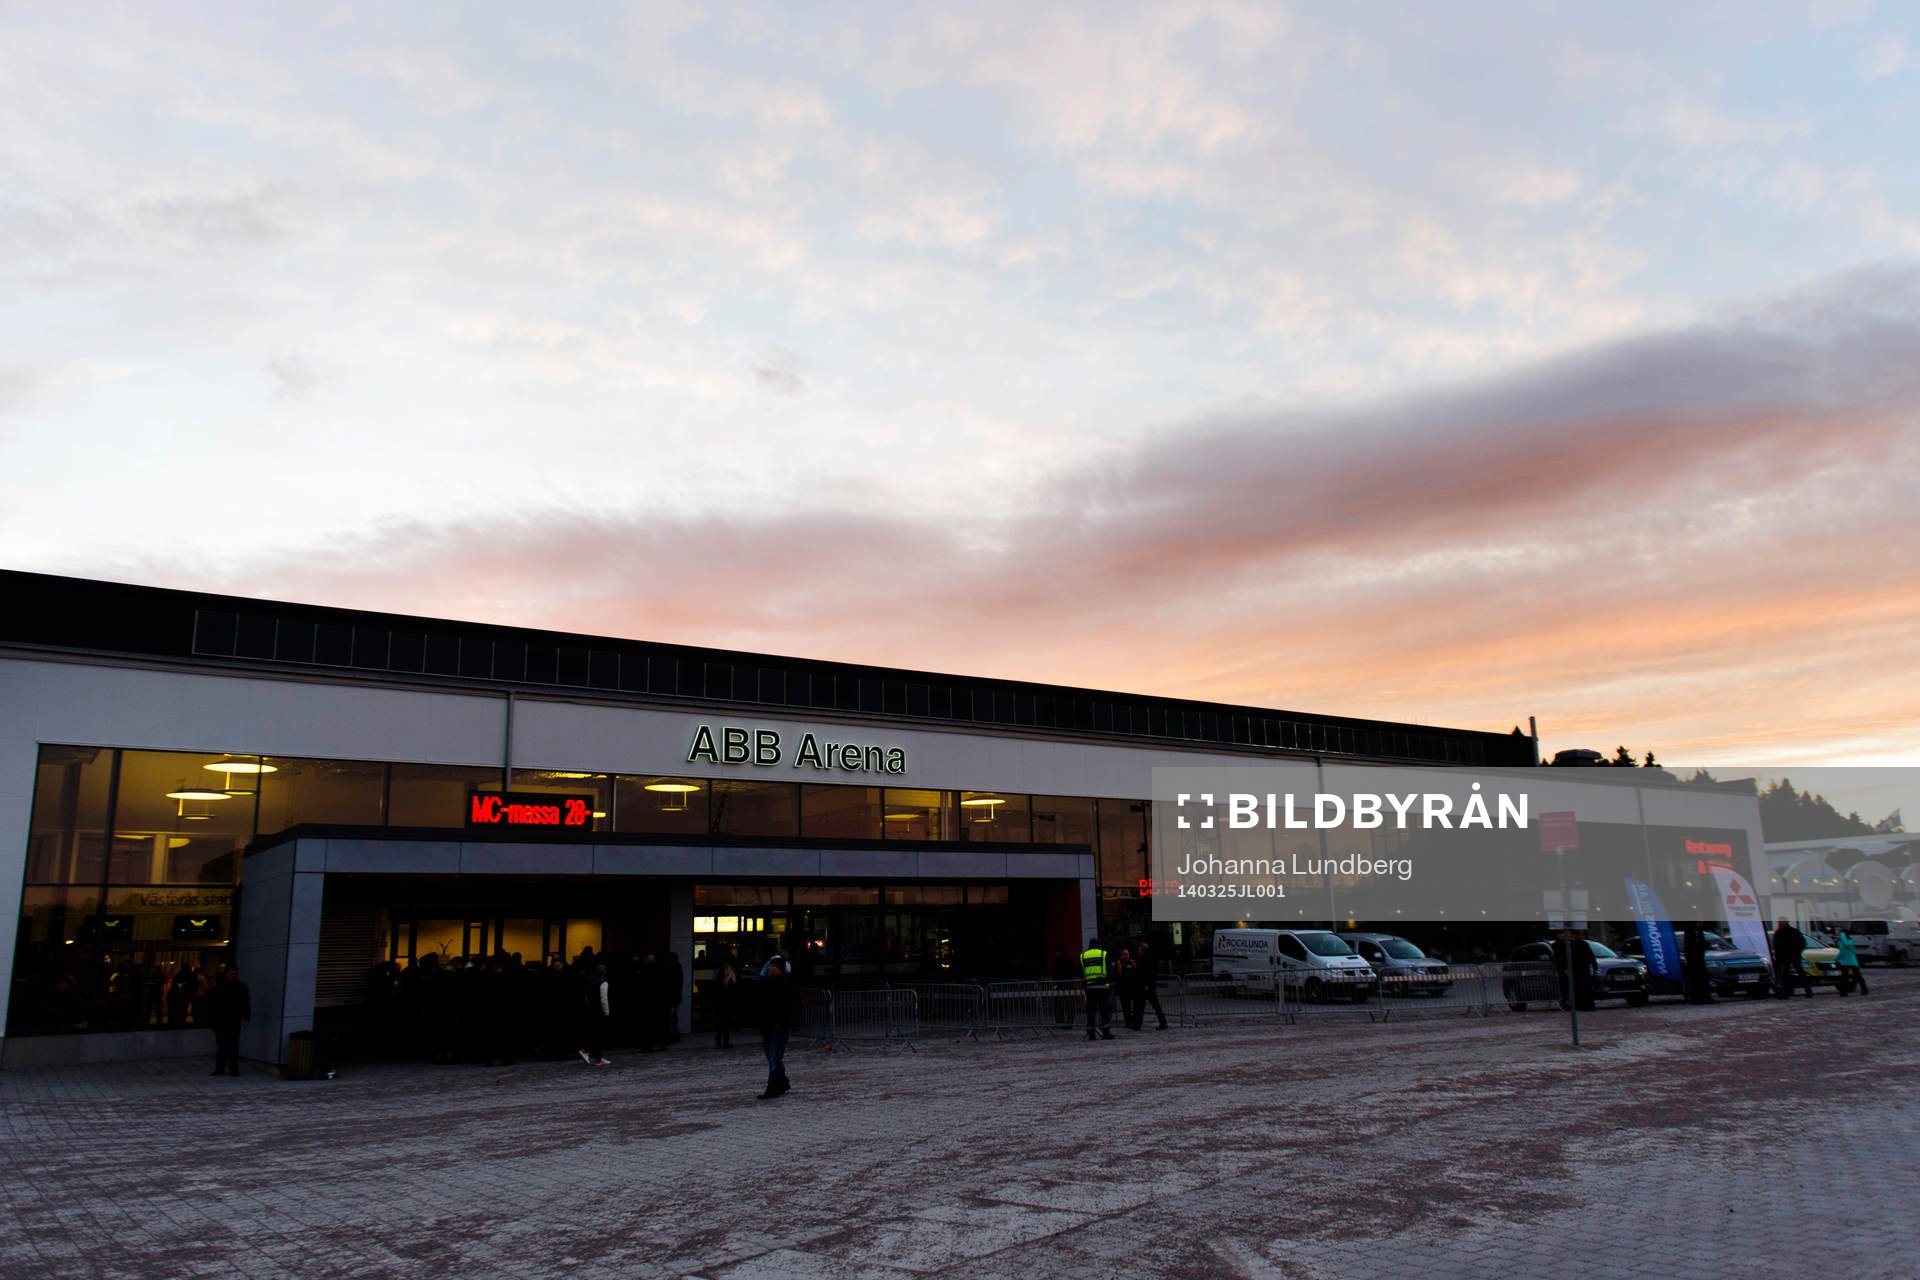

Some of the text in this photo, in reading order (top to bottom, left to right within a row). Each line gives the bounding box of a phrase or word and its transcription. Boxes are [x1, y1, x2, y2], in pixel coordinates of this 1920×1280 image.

[688, 725, 907, 774] ABB Arena
[472, 796, 591, 825] MC-massa 28-
[141, 892, 200, 906] Västerås
